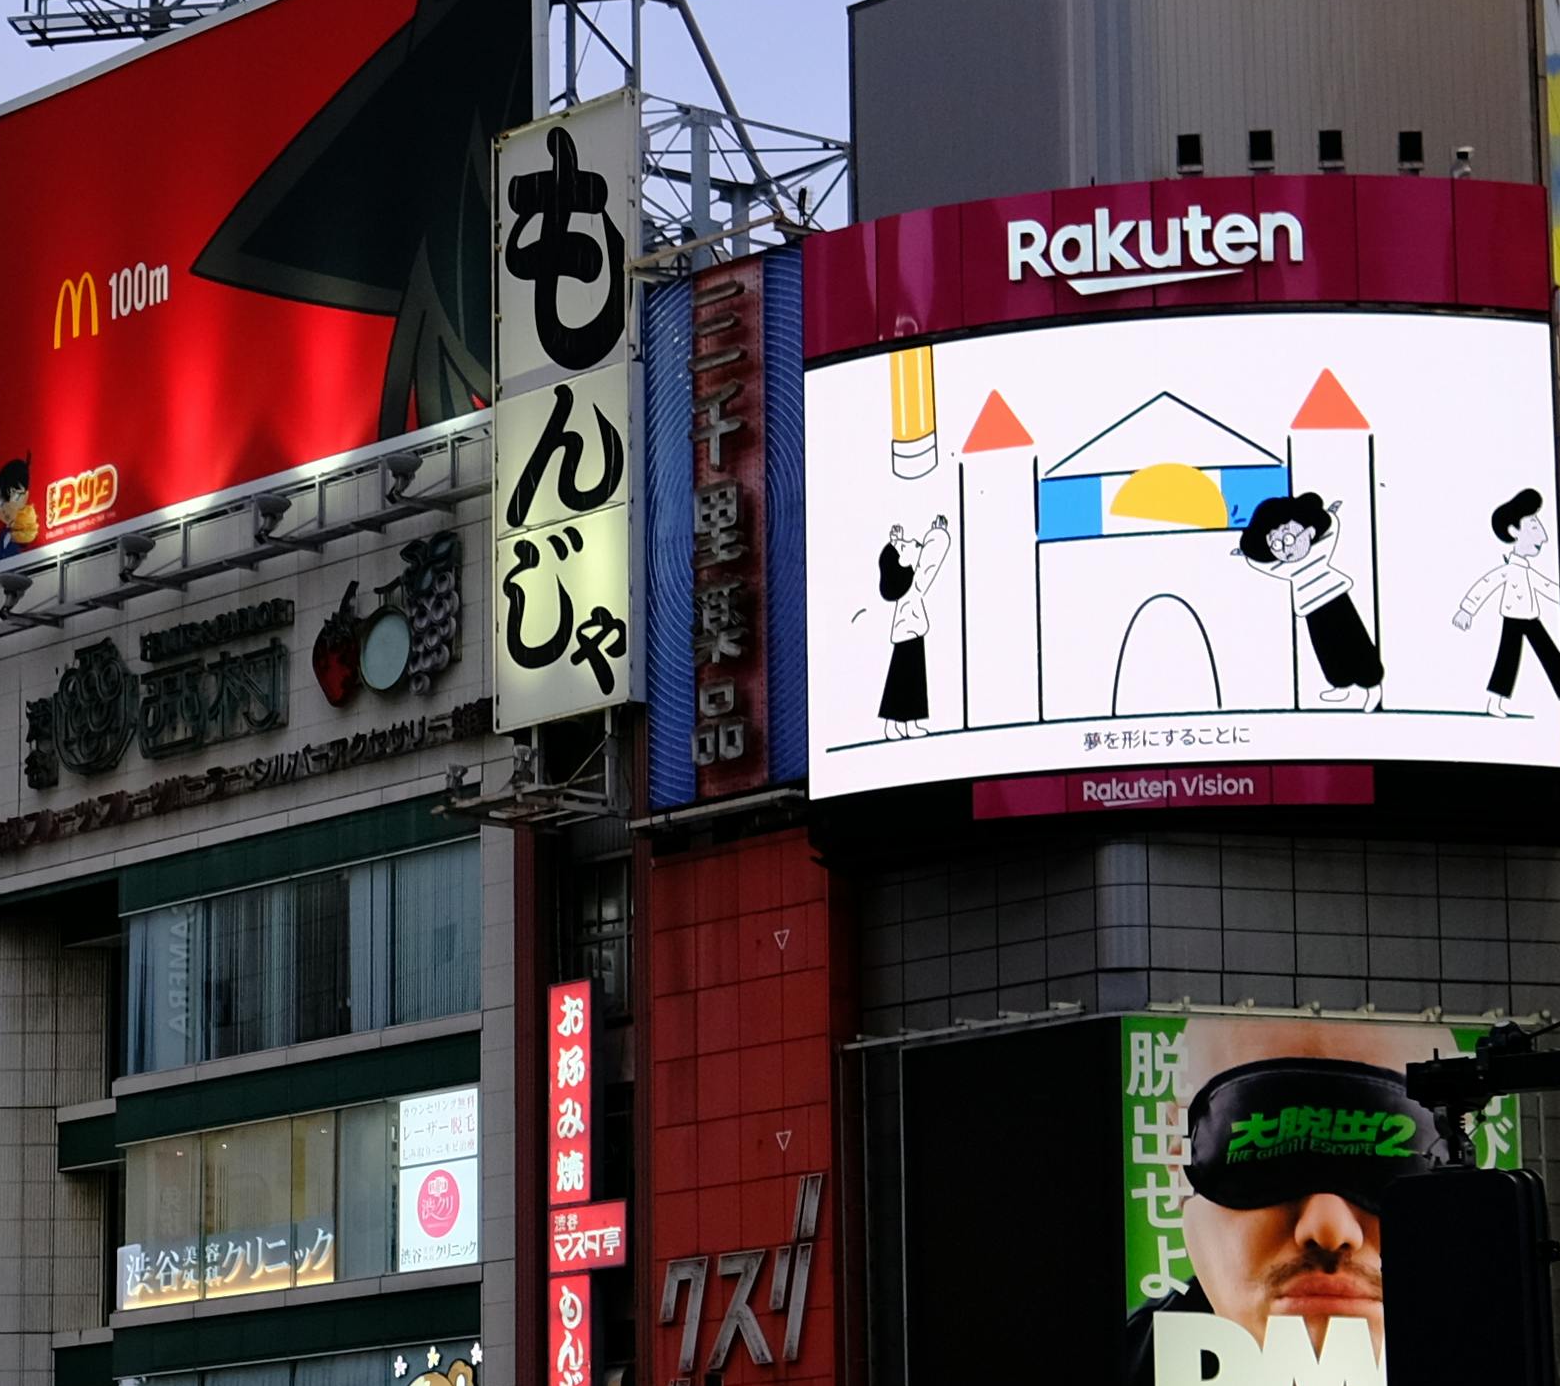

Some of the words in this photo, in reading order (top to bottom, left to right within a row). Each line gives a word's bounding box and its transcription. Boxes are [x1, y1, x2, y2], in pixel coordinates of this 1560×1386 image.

[1007, 206, 1303, 283] Rakuten
[109, 261, 170, 319] 100m
[506, 126, 626, 694] もんじゃ
[688, 277, 745, 767] 三千里薬品
[1084, 726, 1250, 751] 夢を形にすることに
[1082, 778, 1176, 804] Rakuten
[1180, 774, 1254, 797] Vision
[556, 994, 586, 1193] お好み焼
[403, 1115, 475, 1141] レーザー脱毛
[1229, 1107, 1416, 1157] 大脱出2
[1127, 1030, 1193, 1298] 脱出せよ
[554, 1213, 578, 1231] 渋谷
[126, 1250, 180, 1296] 渋谷
[224, 1228, 334, 1283] クリニック
